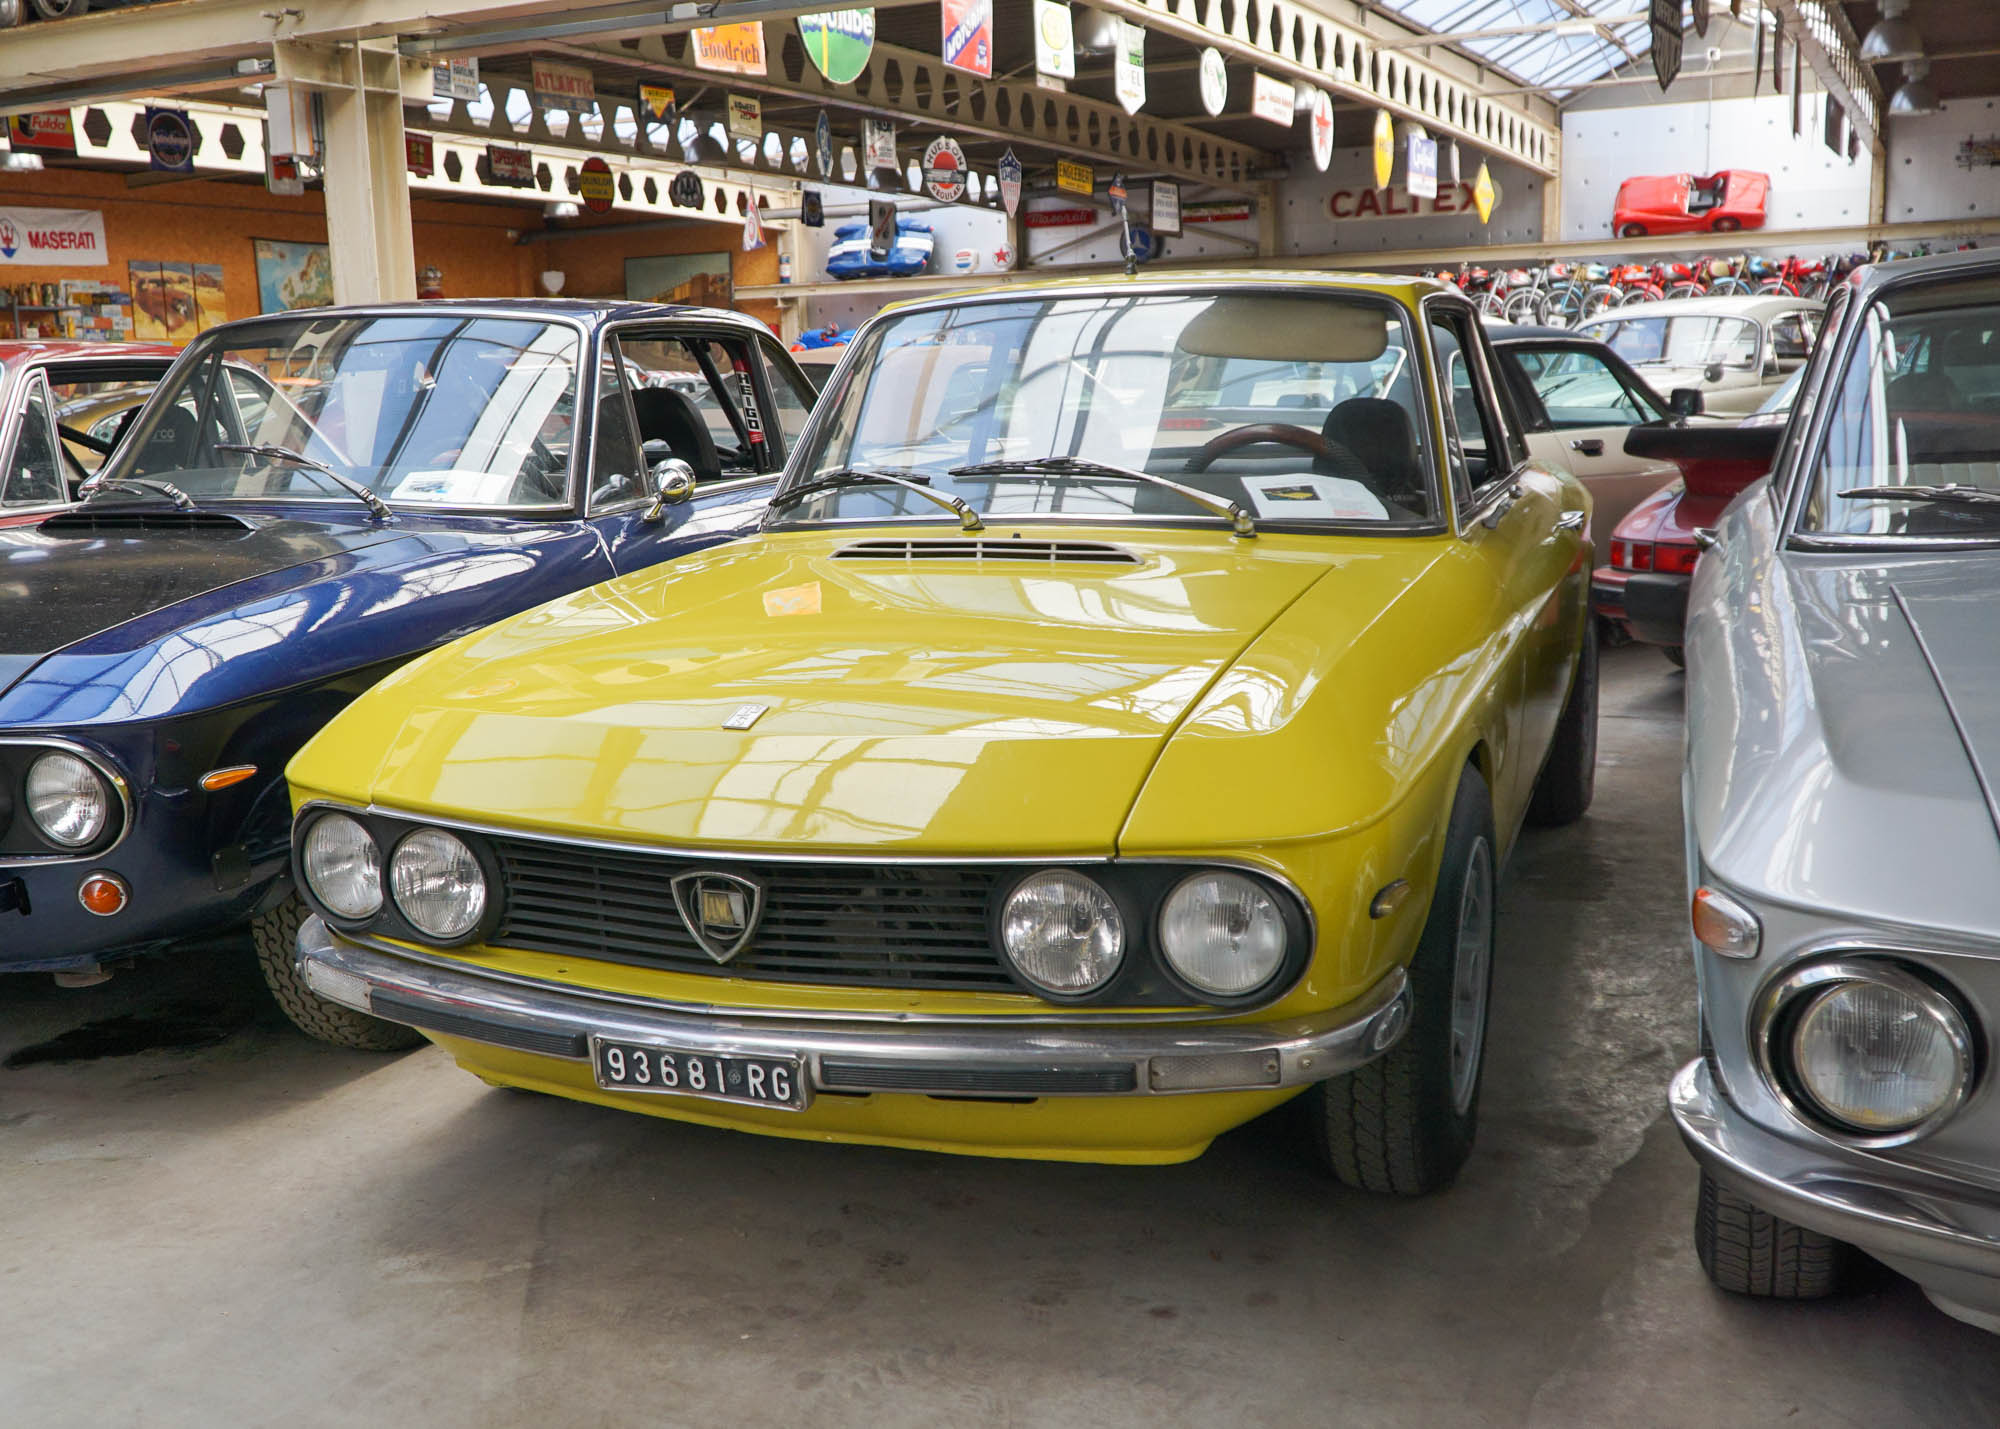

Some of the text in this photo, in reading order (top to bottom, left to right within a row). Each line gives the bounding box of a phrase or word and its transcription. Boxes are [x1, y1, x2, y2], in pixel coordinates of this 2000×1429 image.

[699, 36, 761, 65] Goodrich
[535, 71, 593, 98] ATLANTIC
[31, 115, 66, 131] Fulda
[926, 142, 964, 166] HUDSON
[1058, 161, 1094, 185] ENGLEBERT
[931, 184, 962, 200] REGULAR
[27, 230, 96, 250] MASERATI
[738, 373, 760, 430] HEIGO
[607, 1048, 791, 1101] 93681 RG
